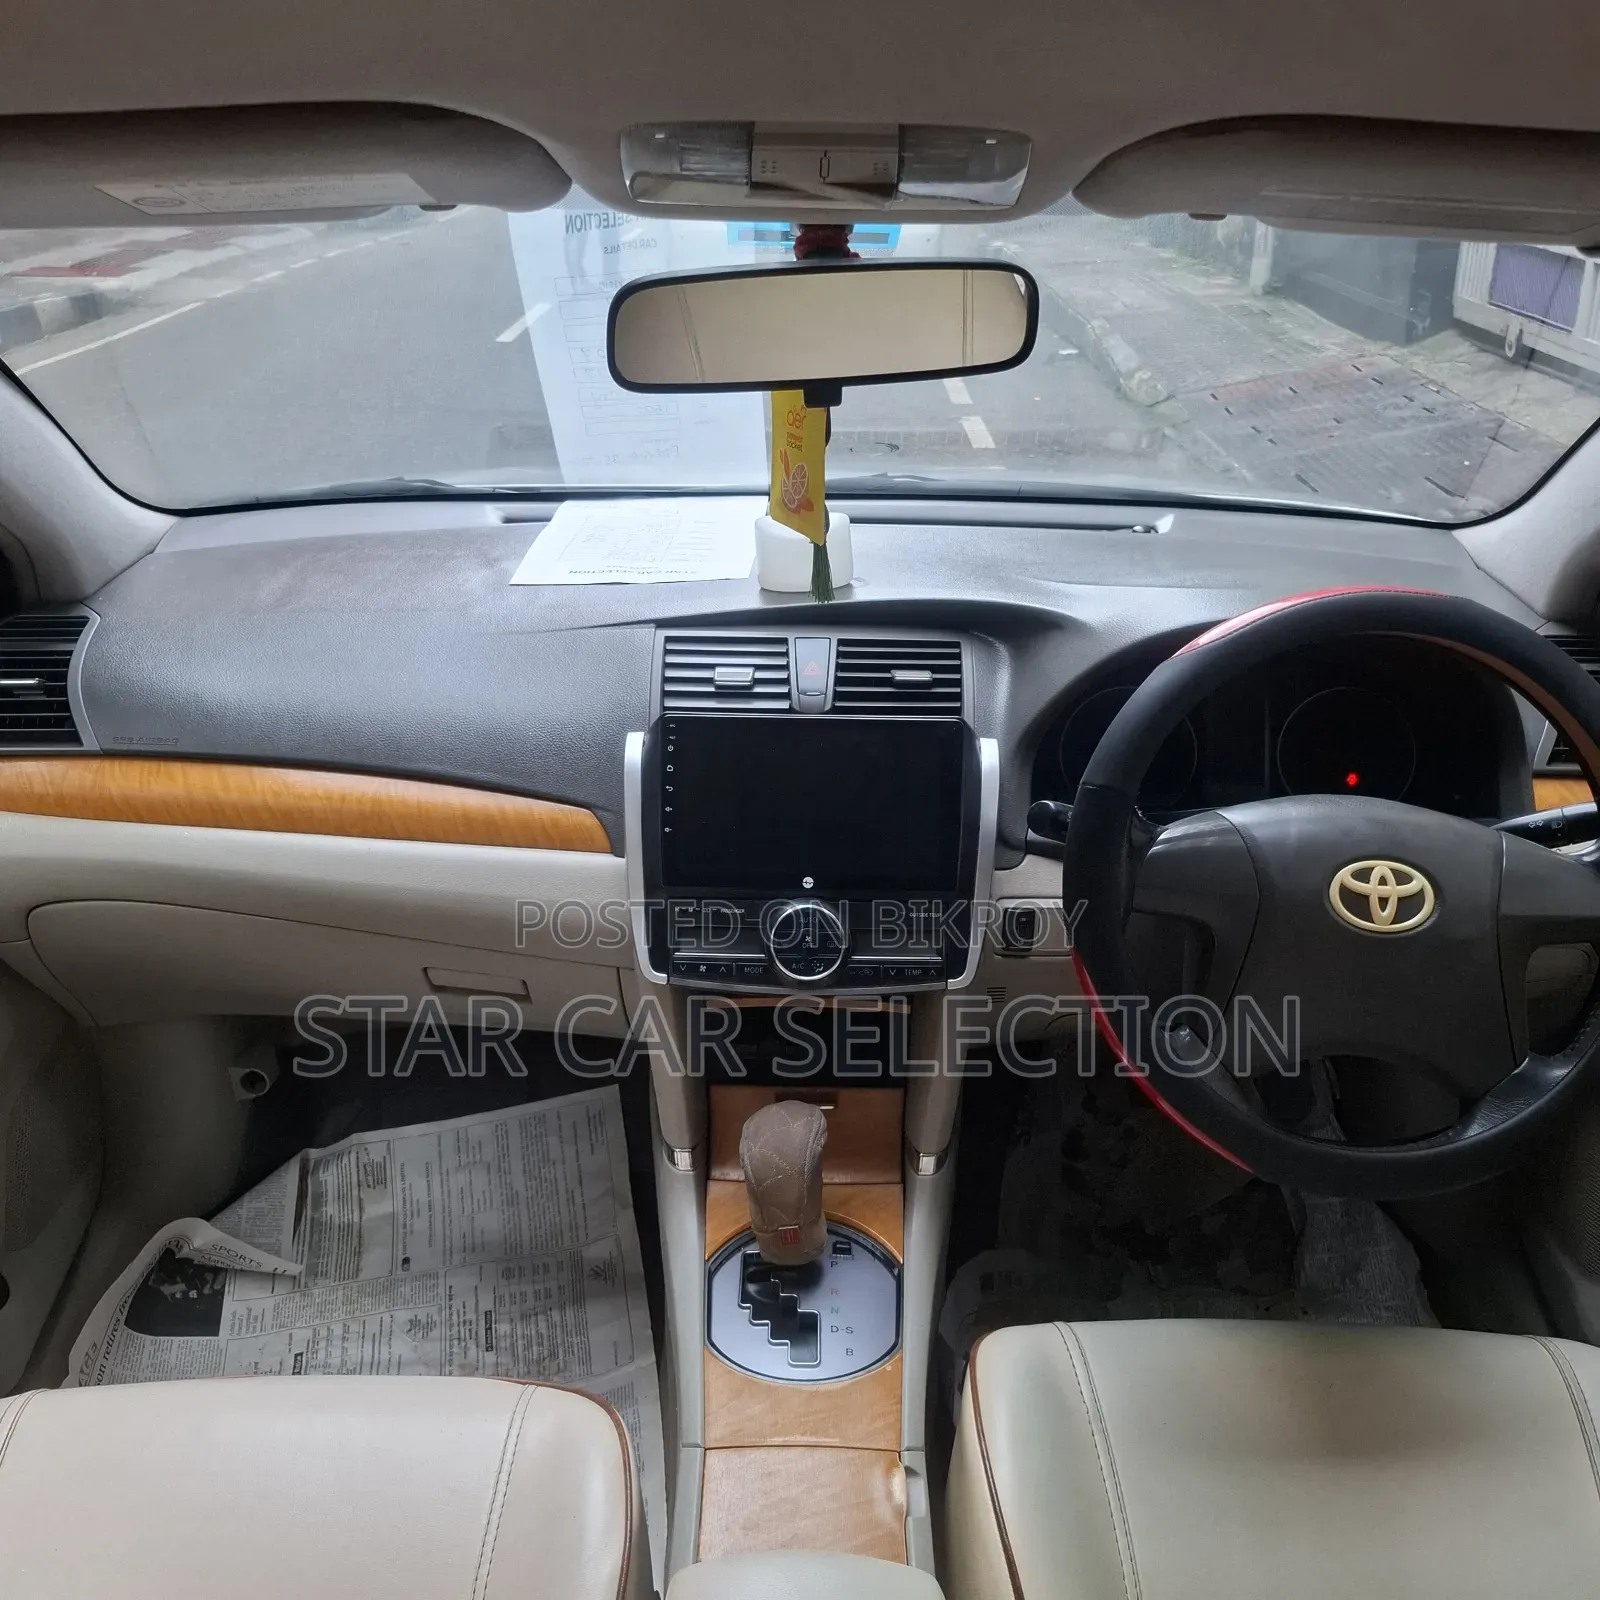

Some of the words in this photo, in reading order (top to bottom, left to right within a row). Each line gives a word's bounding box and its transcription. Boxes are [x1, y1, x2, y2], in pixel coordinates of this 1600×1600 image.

[744, 966, 764, 974] MODE
[904, 968, 922, 976] TEMP
[210, 1243, 263, 1268] SPORTS
[830, 1288, 838, 1296] R
[830, 1306, 839, 1314] N
[103, 1316, 121, 1361] retires
[845, 1348, 854, 1356] B
